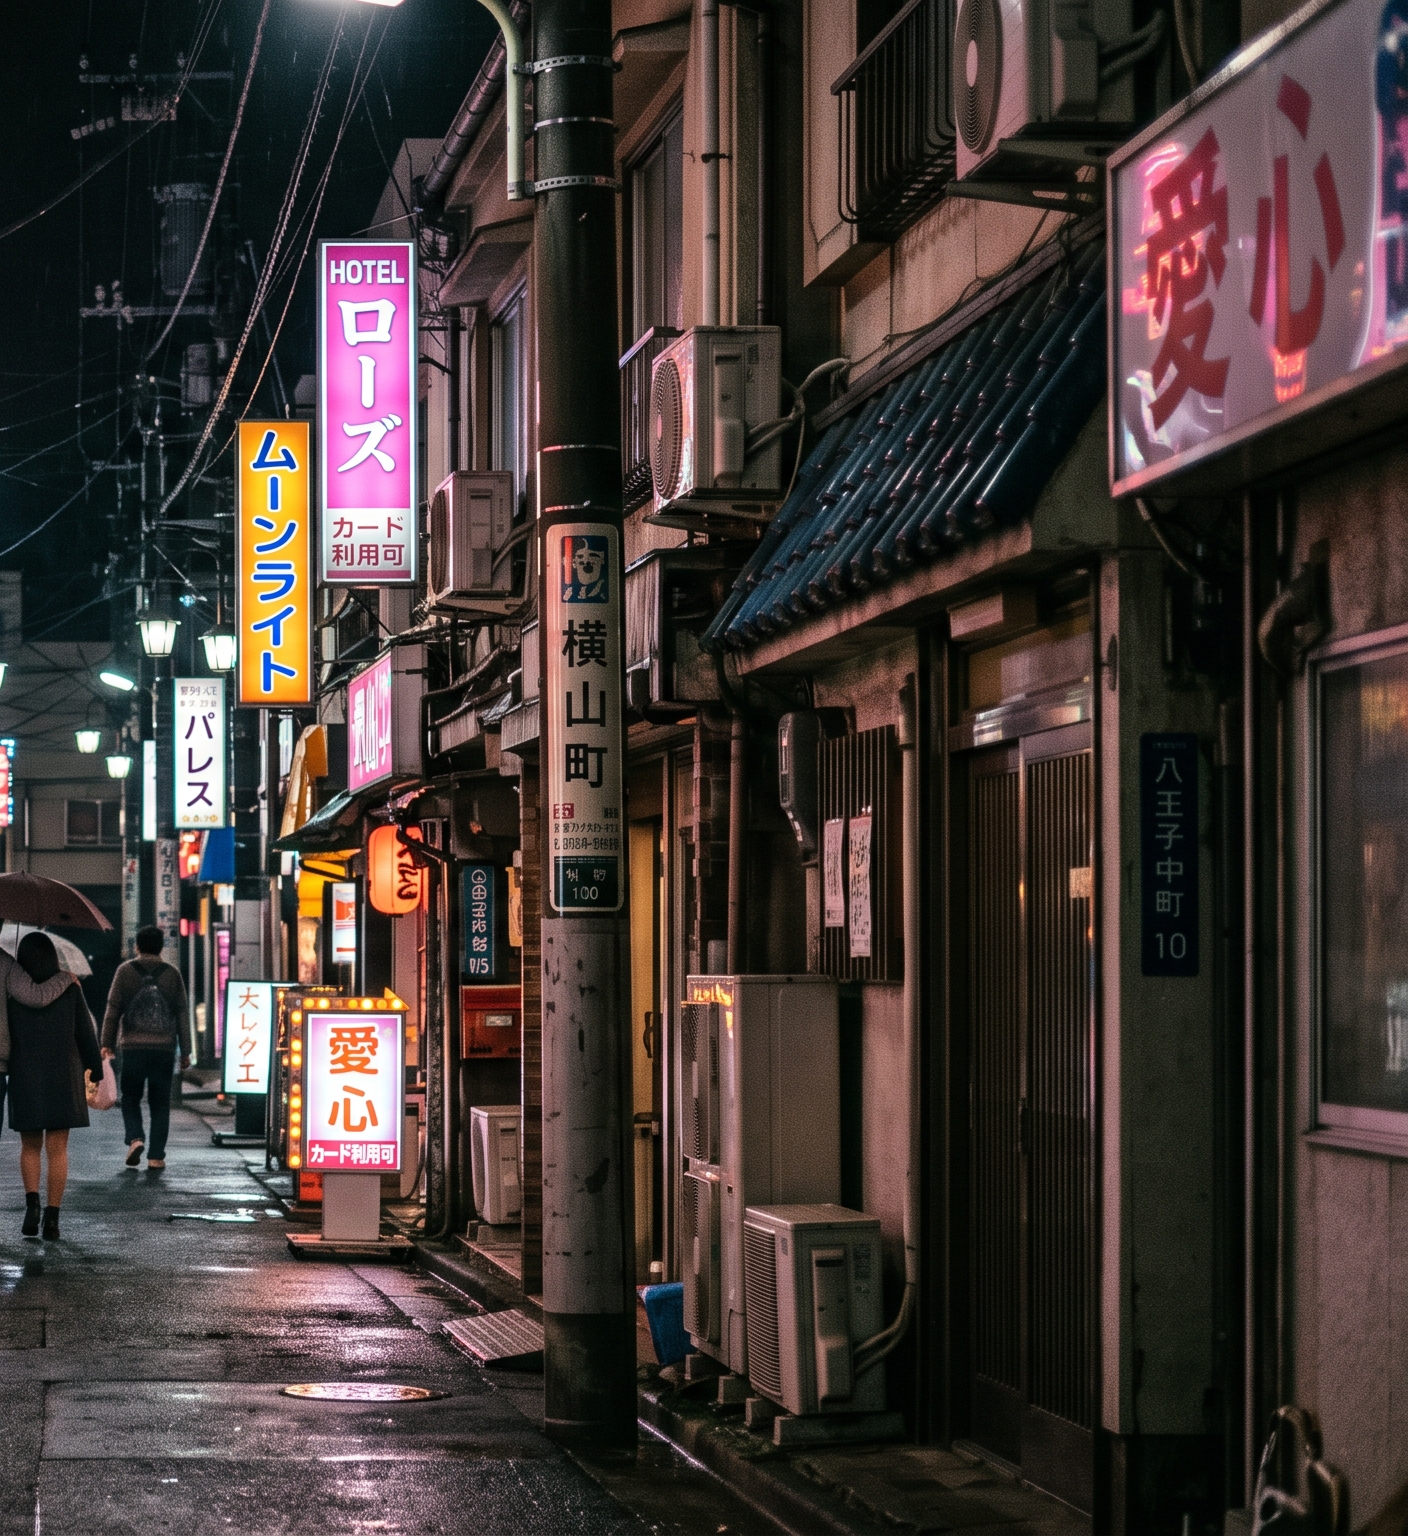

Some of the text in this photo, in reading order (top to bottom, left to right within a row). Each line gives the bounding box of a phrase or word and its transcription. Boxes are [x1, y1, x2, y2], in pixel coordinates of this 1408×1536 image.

[330, 260, 405, 285] HOTEL
[337, 297, 402, 475] ローズ
[332, 516, 404, 541] カード
[332, 544, 405, 567] 利用可
[252, 430, 298, 693] ムーンライト
[562, 619, 608, 789] 横山町
[185, 712, 215, 807] パレス
[1155, 757, 1184, 917] 八王子中町
[572, 886, 599, 900] 100
[1155, 932, 1186, 959] 10
[328, 1026, 379, 1133] 愛心
[310, 1143, 396, 1165] カード利用可
